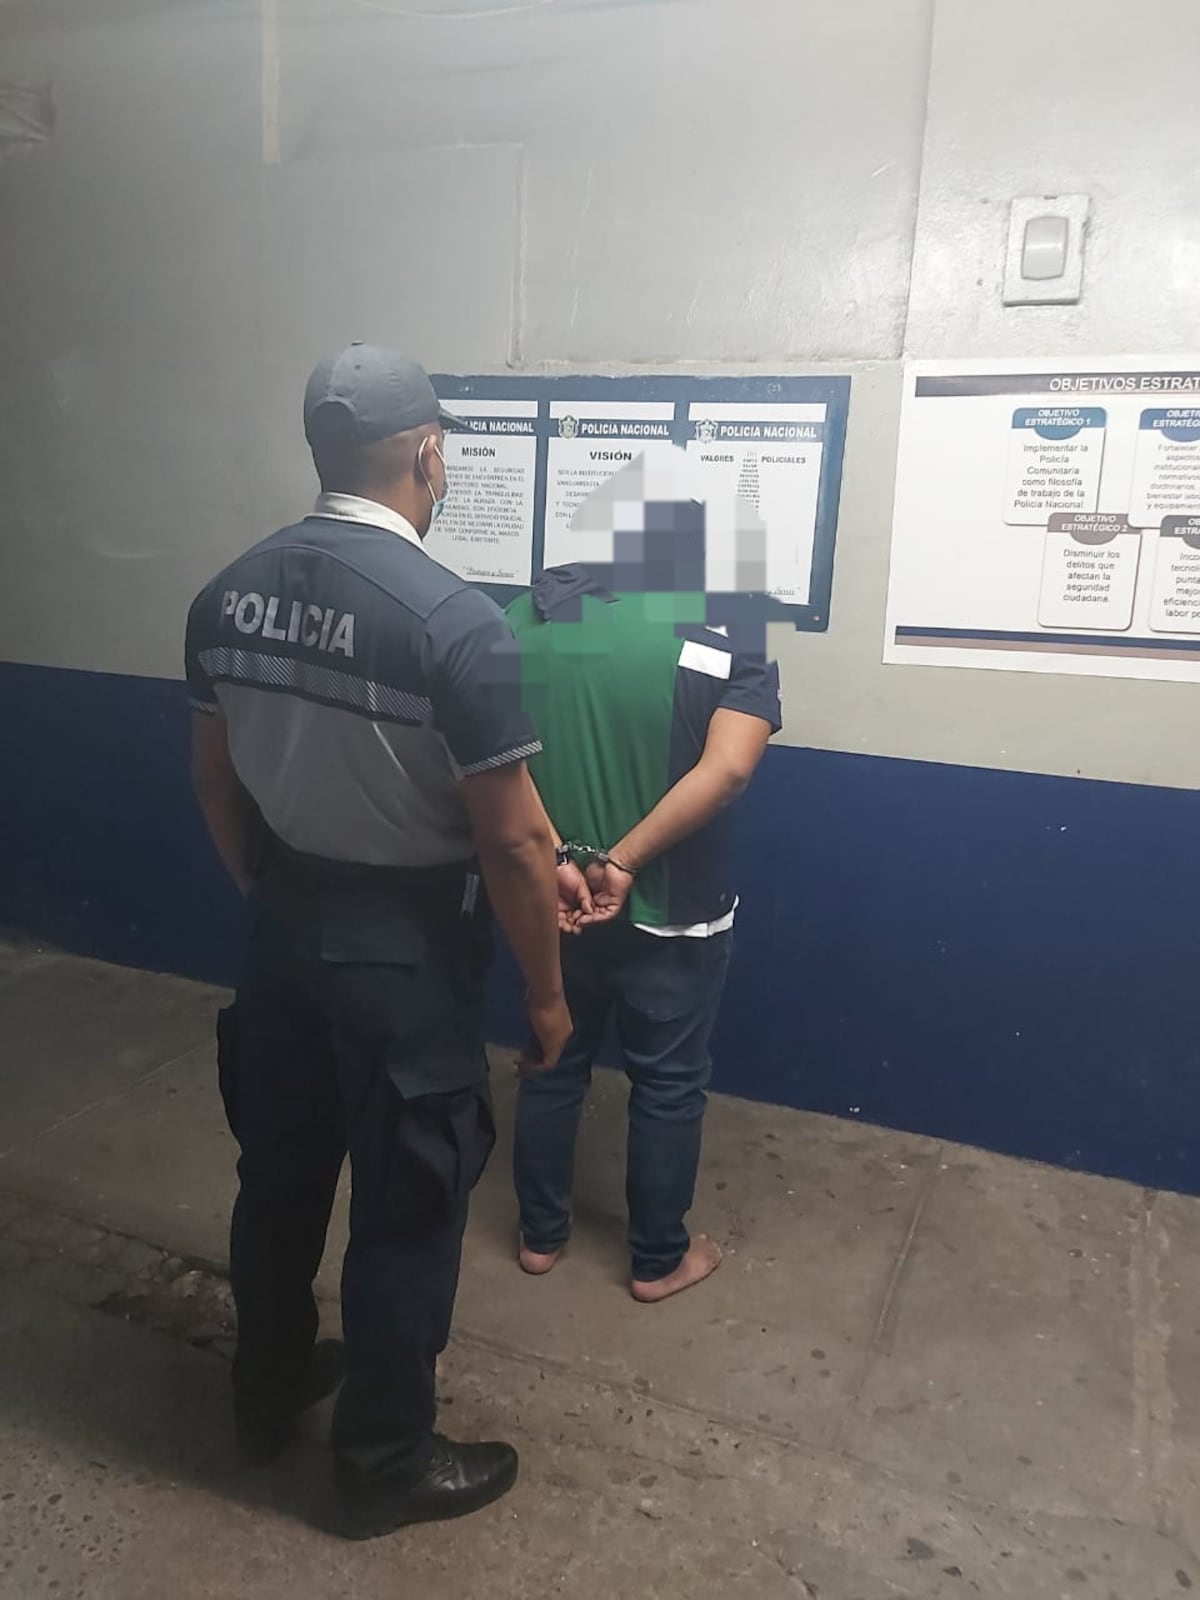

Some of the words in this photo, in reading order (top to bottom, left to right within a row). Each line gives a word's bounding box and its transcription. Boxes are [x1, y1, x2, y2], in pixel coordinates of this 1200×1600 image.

[1050, 377, 1136, 391] OBJETIVOS
[1038, 409, 1080, 417] OBJETIVO
[1025, 417, 1084, 426] ESTRATÉGICO
[489, 421, 534, 433] NACIONAL
[581, 423, 618, 435] POLICIA
[620, 424, 669, 436] NACIONAL
[720, 425, 760, 437] POLICIA
[763, 426, 816, 438] NACIONAL
[461, 446, 496, 457] MISIÓN
[1024, 444, 1078, 454] Implementar
[1080, 444, 1088, 452] la
[590, 450, 632, 461] VISIÓN
[700, 454, 734, 462] VALORES
[761, 456, 806, 464] POLICIALES
[1027, 466, 1080, 475] Comunitaria
[1017, 489, 1028, 497] de
[1031, 489, 1061, 499] trabajo
[1074, 514, 1117, 523] OBJETIVO
[1061, 524, 1120, 532] ESTRATÉGICO
[1063, 549, 1105, 558] Disminuir
[1107, 550, 1120, 558] los
[1066, 561, 1095, 569] delitos
[1098, 562, 1115, 570] que
[1067, 572, 1100, 580] afectan
[1066, 583, 1110, 592] seguridad
[222, 590, 355, 658] POLICIA
